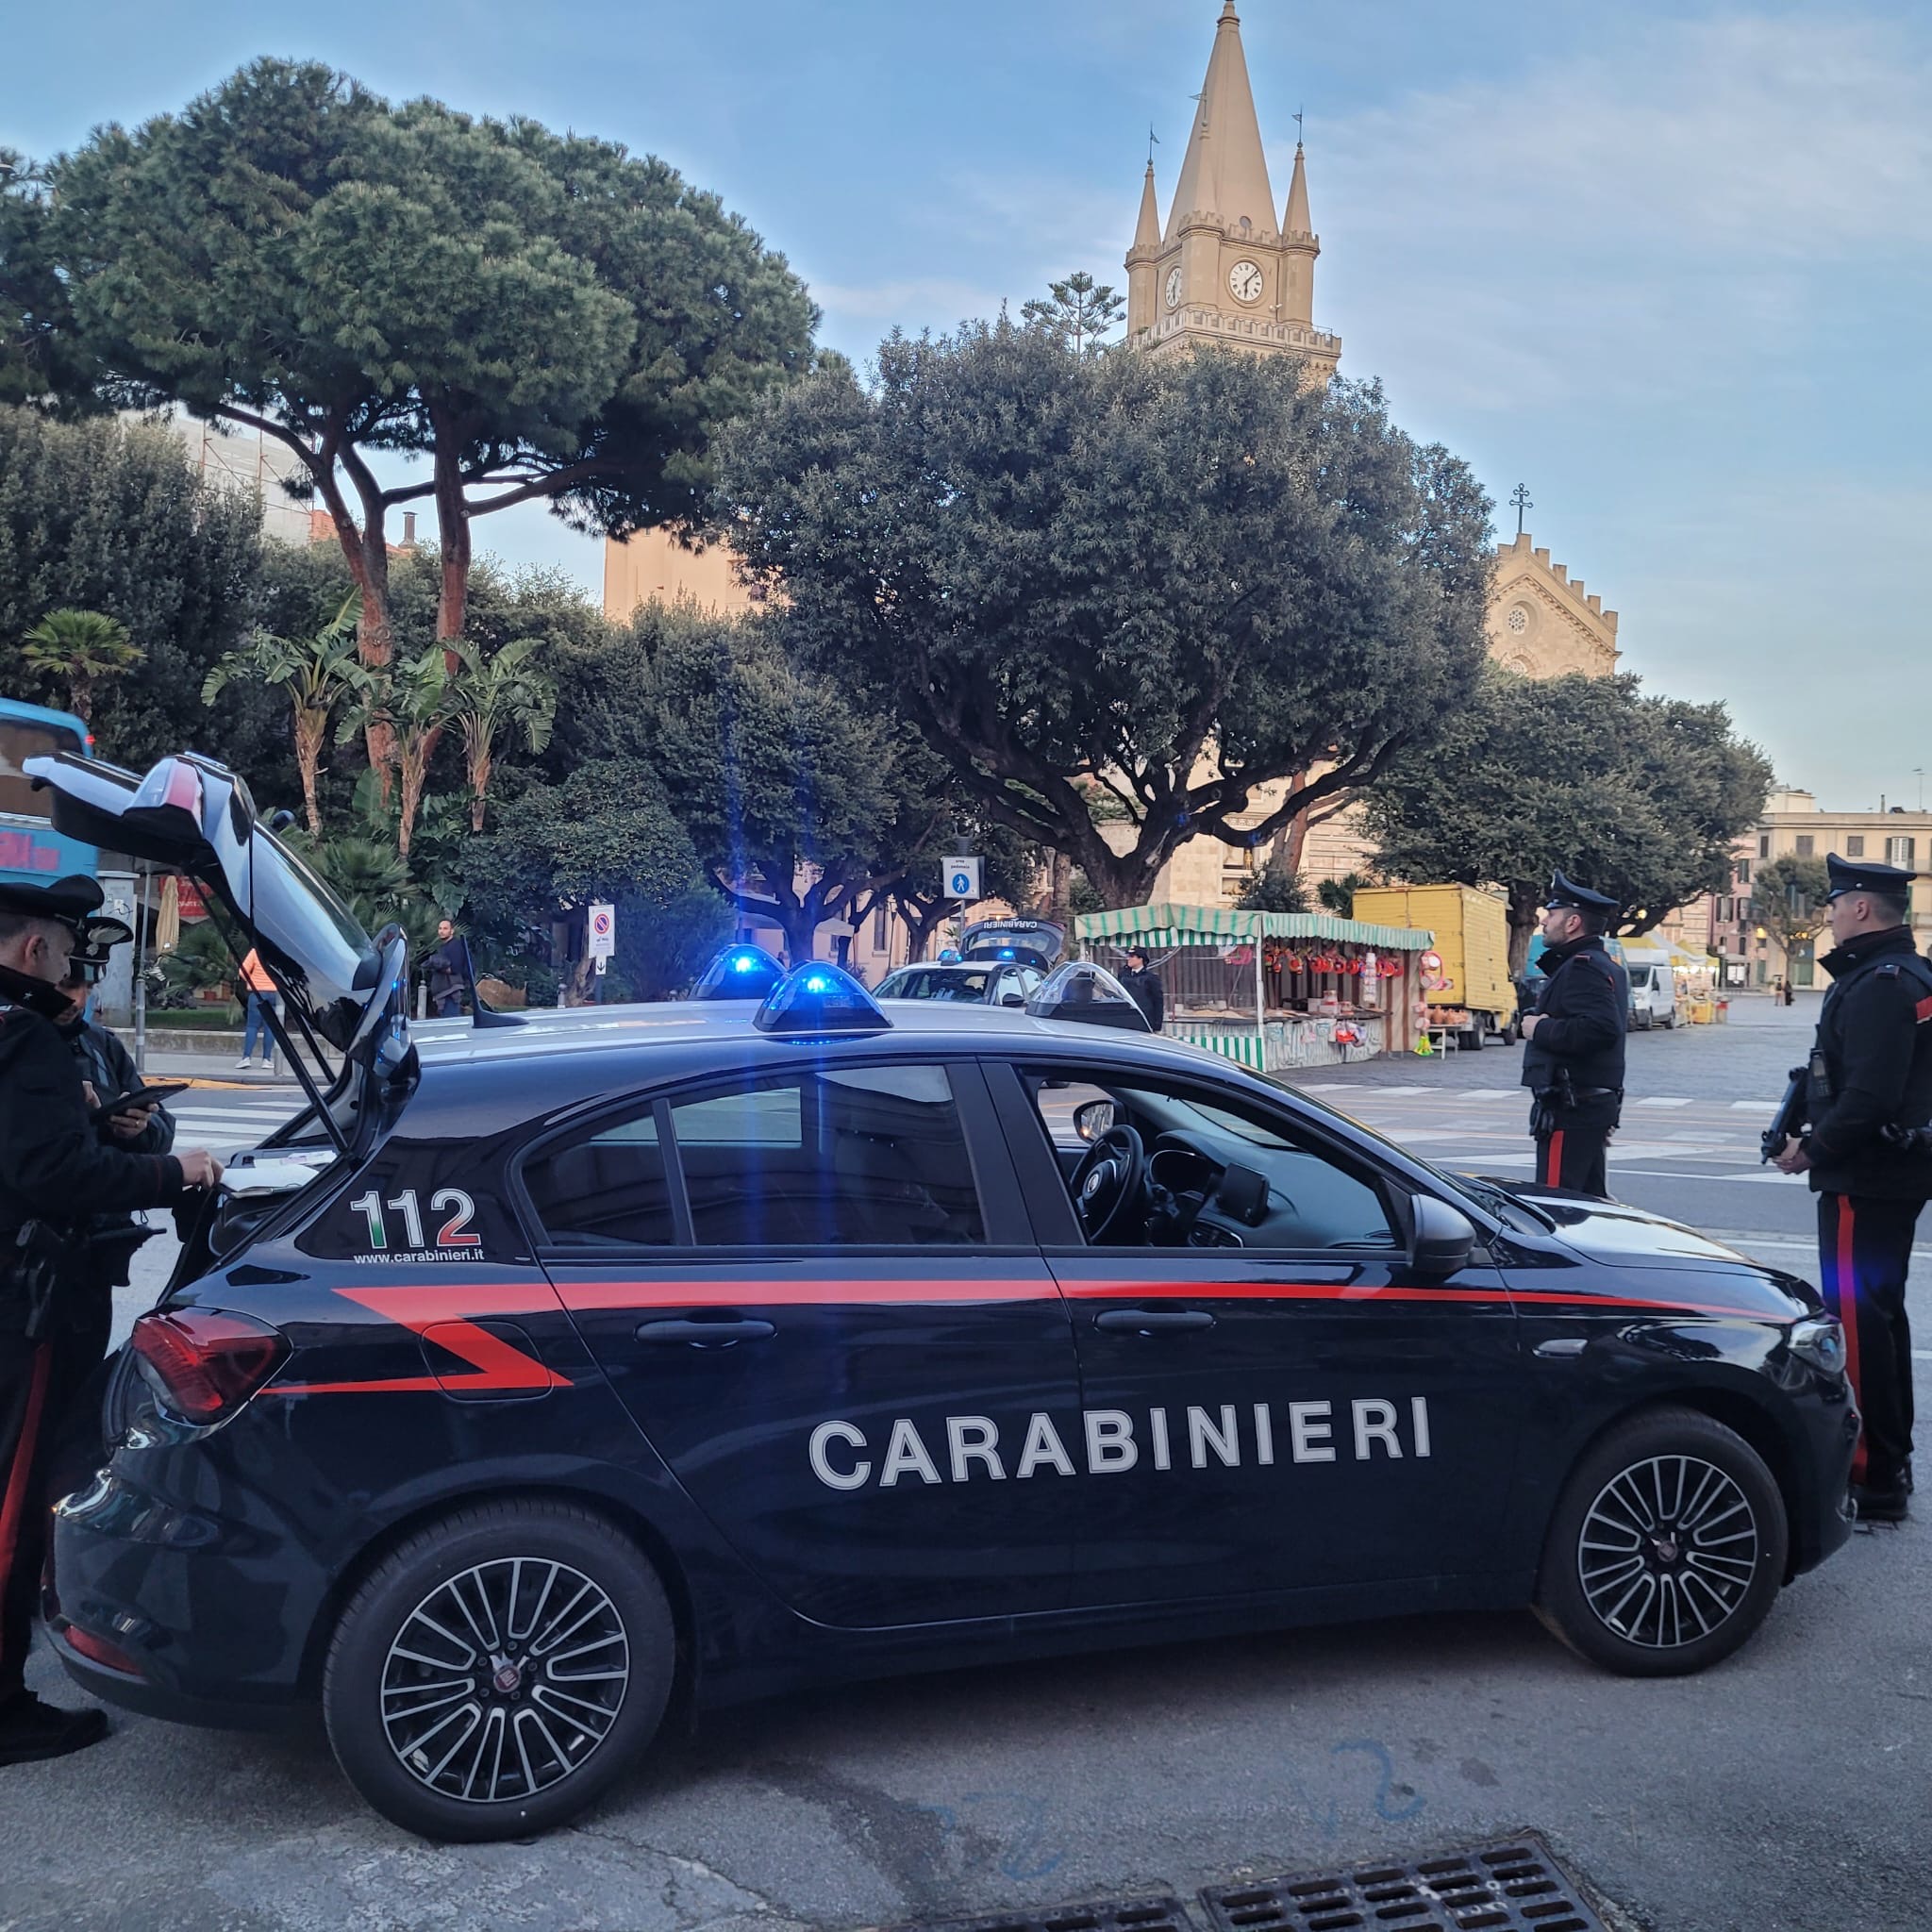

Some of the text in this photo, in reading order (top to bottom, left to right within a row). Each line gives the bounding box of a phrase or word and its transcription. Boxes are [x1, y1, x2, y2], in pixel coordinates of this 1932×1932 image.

[983, 921, 1038, 929] CARABINIERI
[350, 1188, 482, 1249] 112
[354, 1249, 485, 1264] www.carabinieri.it
[808, 1396, 1432, 1491] CARABINIERI
